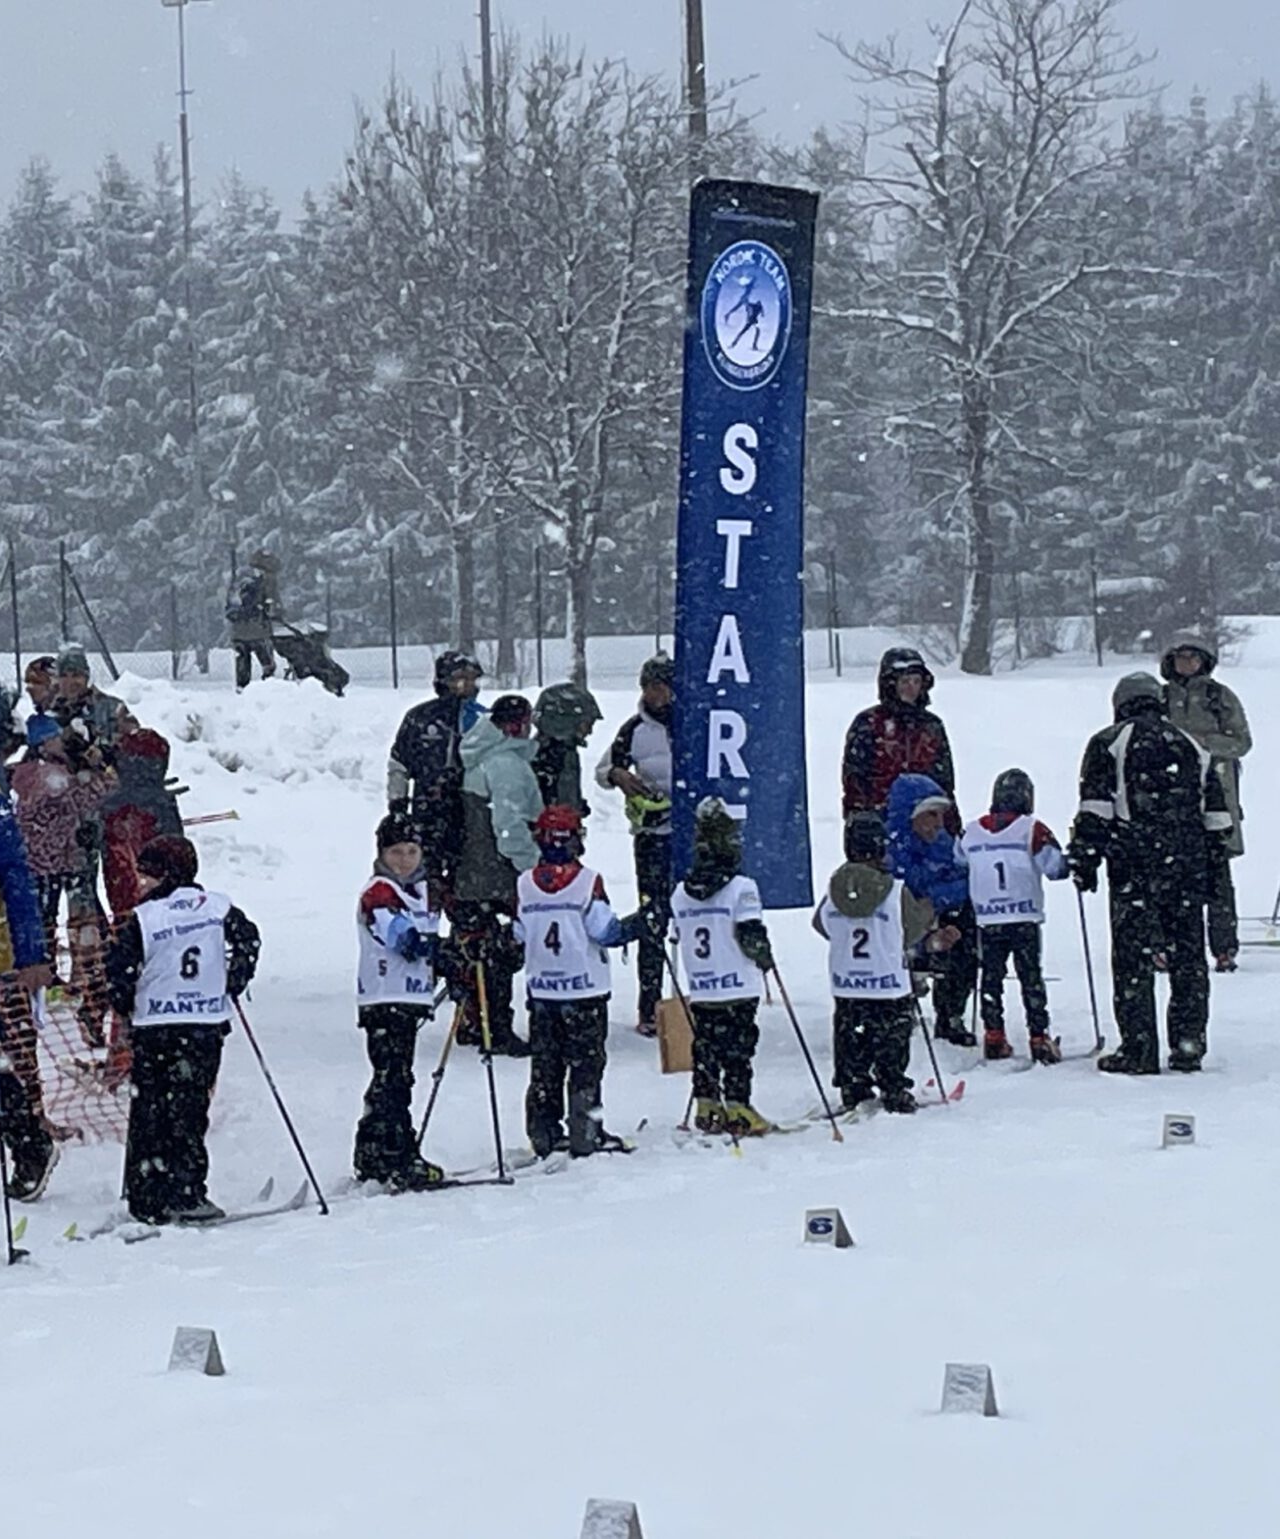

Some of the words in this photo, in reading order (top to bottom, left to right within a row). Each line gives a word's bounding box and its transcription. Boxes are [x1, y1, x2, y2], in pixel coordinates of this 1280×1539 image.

[759, 251, 785, 292] TEAM
[994, 861, 1006, 890] 1
[544, 921, 561, 956] 4
[695, 927, 710, 958] 3
[852, 929, 869, 959] 2
[180, 946, 201, 981] 6
[379, 959, 387, 976] 5
[690, 972, 743, 990] ANTEL
[1168, 1121, 1193, 1137] 3
[808, 1217, 833, 1235] 6
